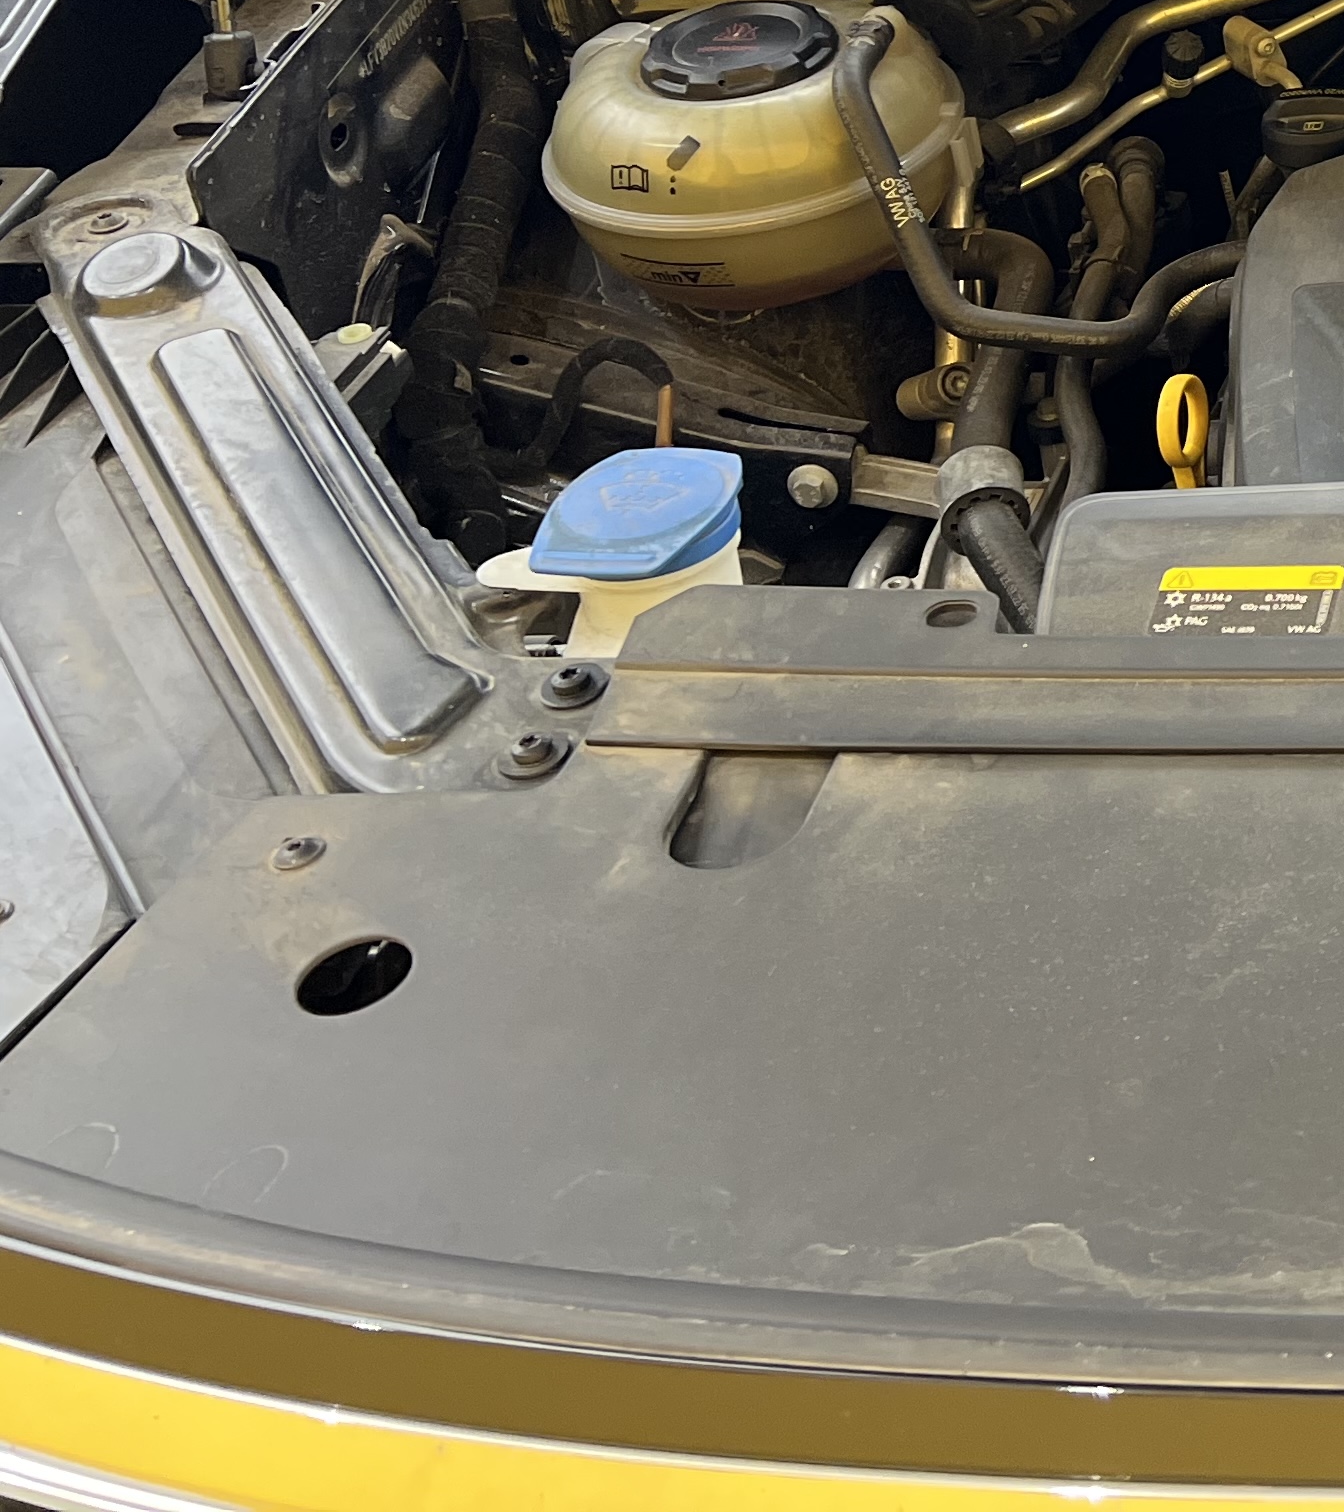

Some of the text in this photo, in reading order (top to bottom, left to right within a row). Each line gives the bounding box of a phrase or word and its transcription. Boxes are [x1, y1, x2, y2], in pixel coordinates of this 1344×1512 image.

[880, 177, 910, 228] VW AG
[650, 270, 684, 283] min
[1294, 593, 1309, 604] kg
[1184, 616, 1209, 626] PAG
[1287, 625, 1322, 634] VW AG
